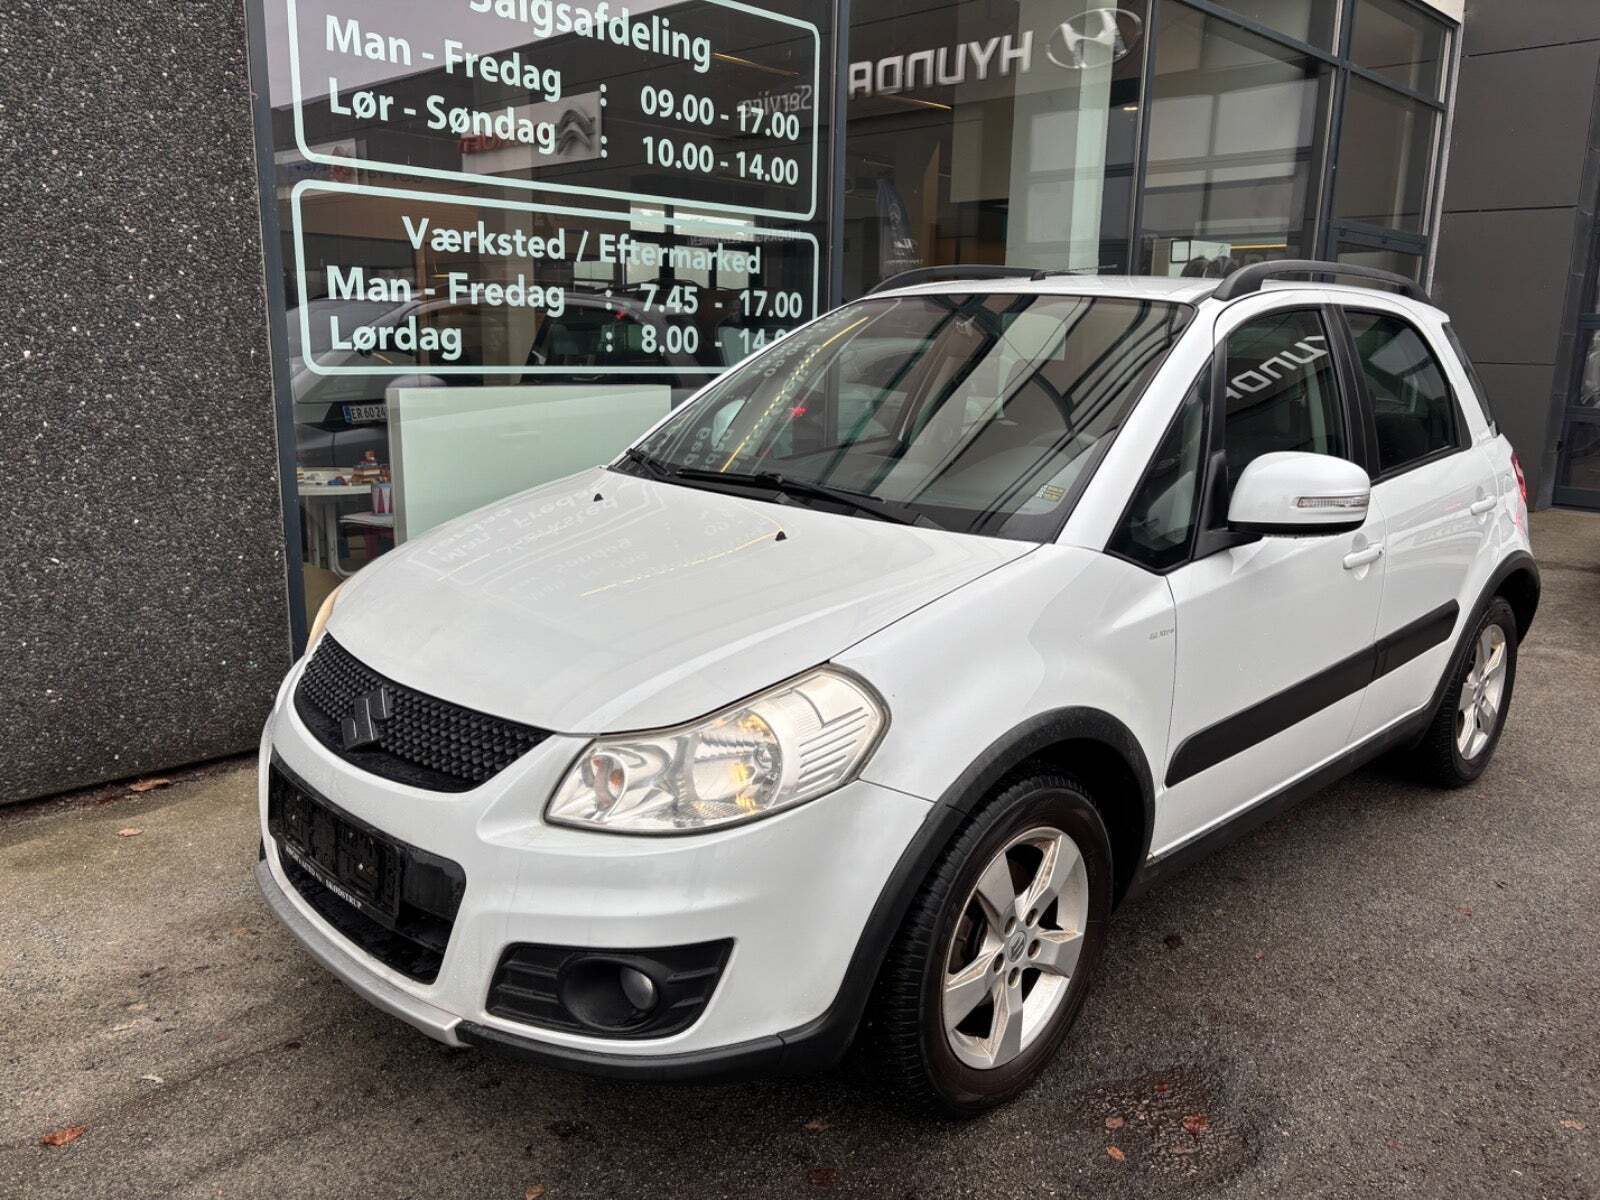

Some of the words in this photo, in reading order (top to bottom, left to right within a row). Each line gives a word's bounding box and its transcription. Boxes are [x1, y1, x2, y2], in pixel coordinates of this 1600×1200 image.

[326, 15, 412, 66] Man
[445, 40, 562, 102] Fredag
[641, 86, 714, 125] 09.00
[737, 105, 799, 141] 17.00
[329, 78, 393, 122] Lør
[426, 95, 556, 155] Søndag
[642, 136, 714, 172] 10.00
[736, 152, 799, 186] 14.00
[402, 216, 565, 261] Værksted
[600, 234, 760, 275] Eftermarked
[327, 265, 411, 302] Man
[449, 272, 565, 318] Fredag
[640, 283, 698, 314] 7.45
[739, 290, 802, 318] 17.00
[330, 315, 462, 360] Lørdag
[641, 325, 698, 353] 8.00
